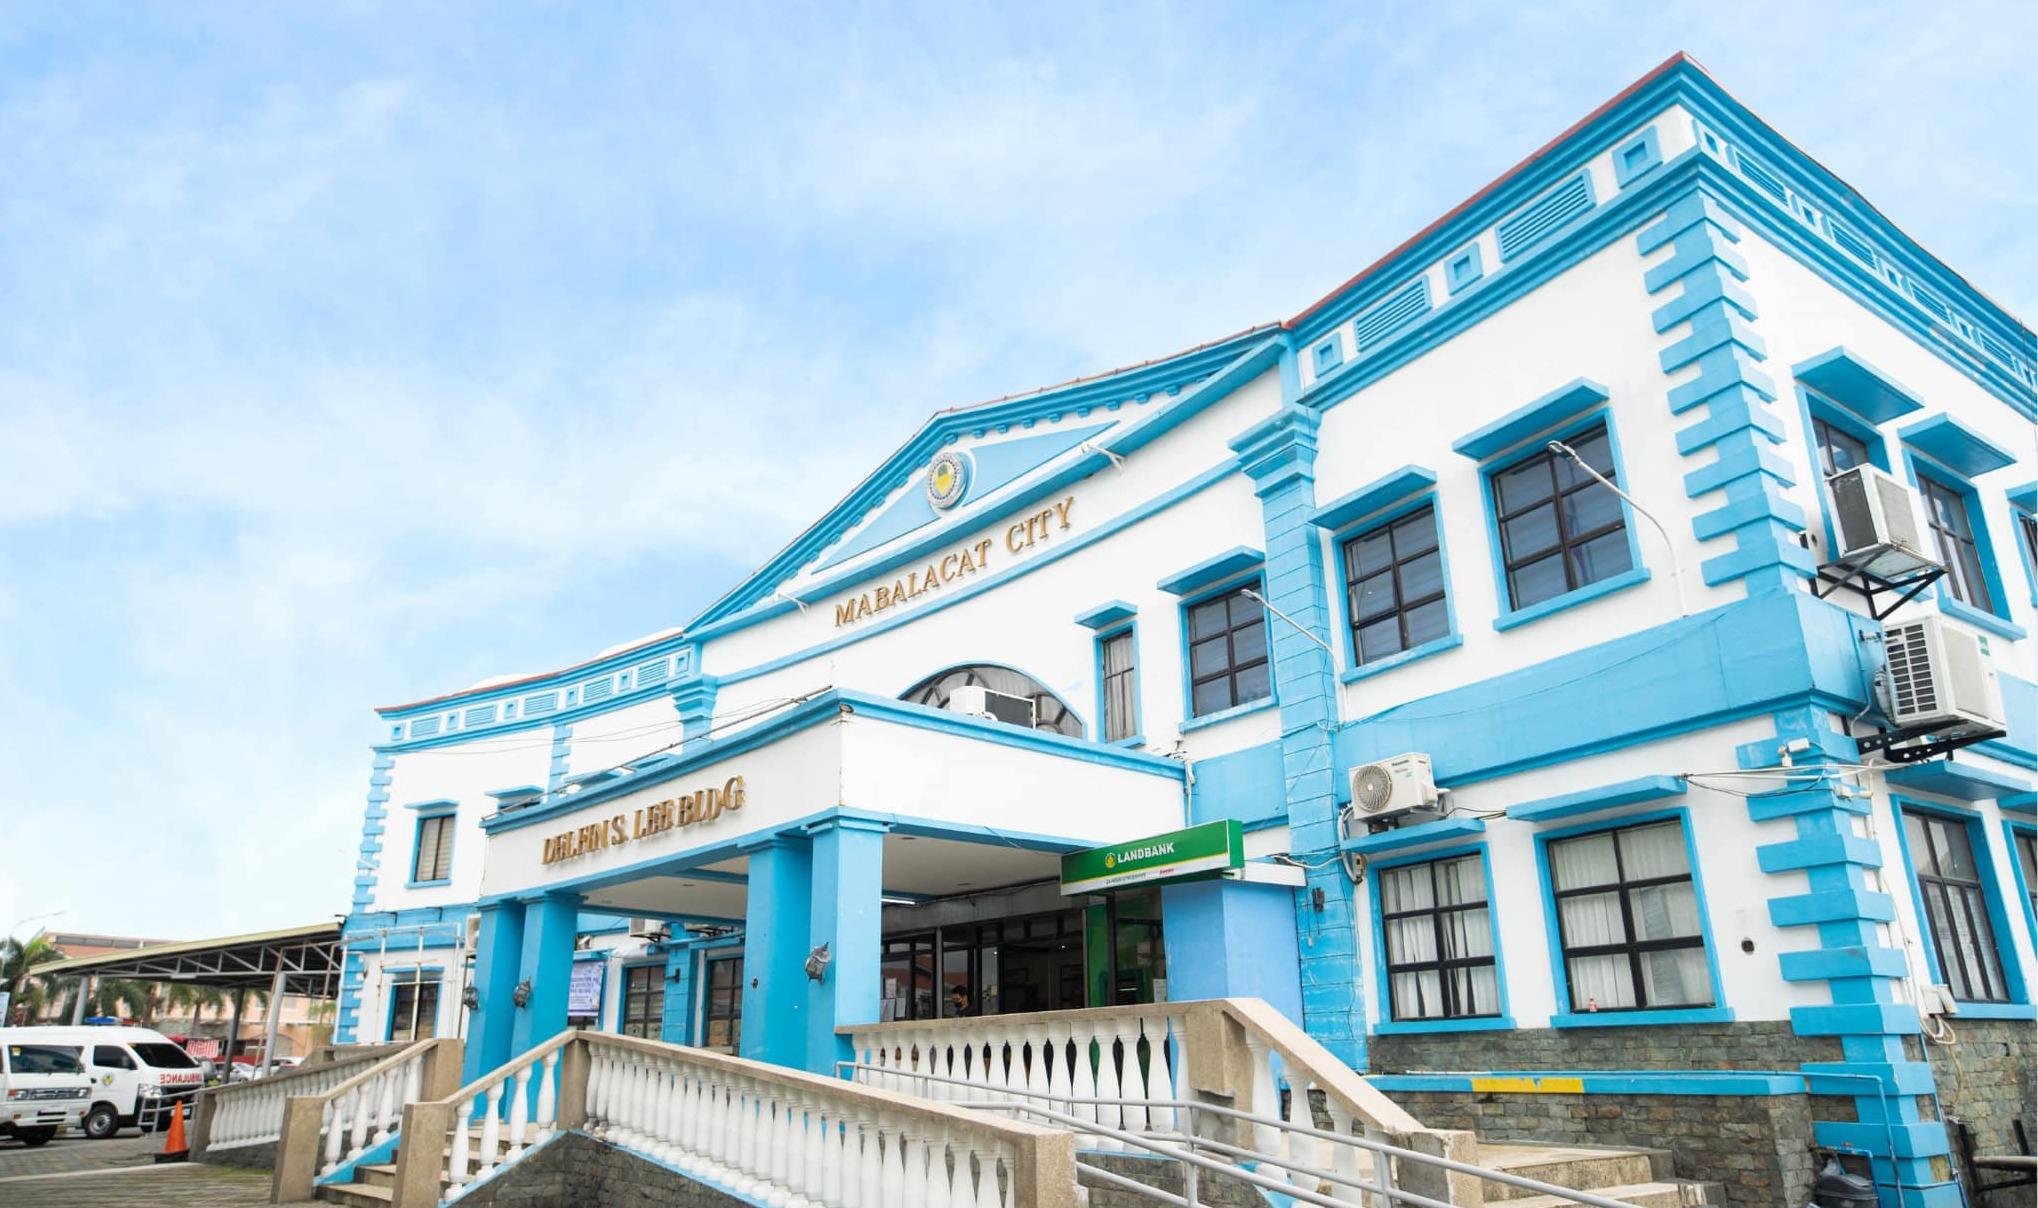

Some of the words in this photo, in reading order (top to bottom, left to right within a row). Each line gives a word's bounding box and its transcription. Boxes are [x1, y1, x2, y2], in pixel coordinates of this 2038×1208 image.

[834, 538, 993, 628] MABALACAT
[1005, 496, 1075, 554] CITY
[542, 819, 610, 864] DELFIN
[633, 799, 673, 839] LEE
[676, 775, 745, 827] BLDG
[1117, 842, 1175, 864] LANDBANK
